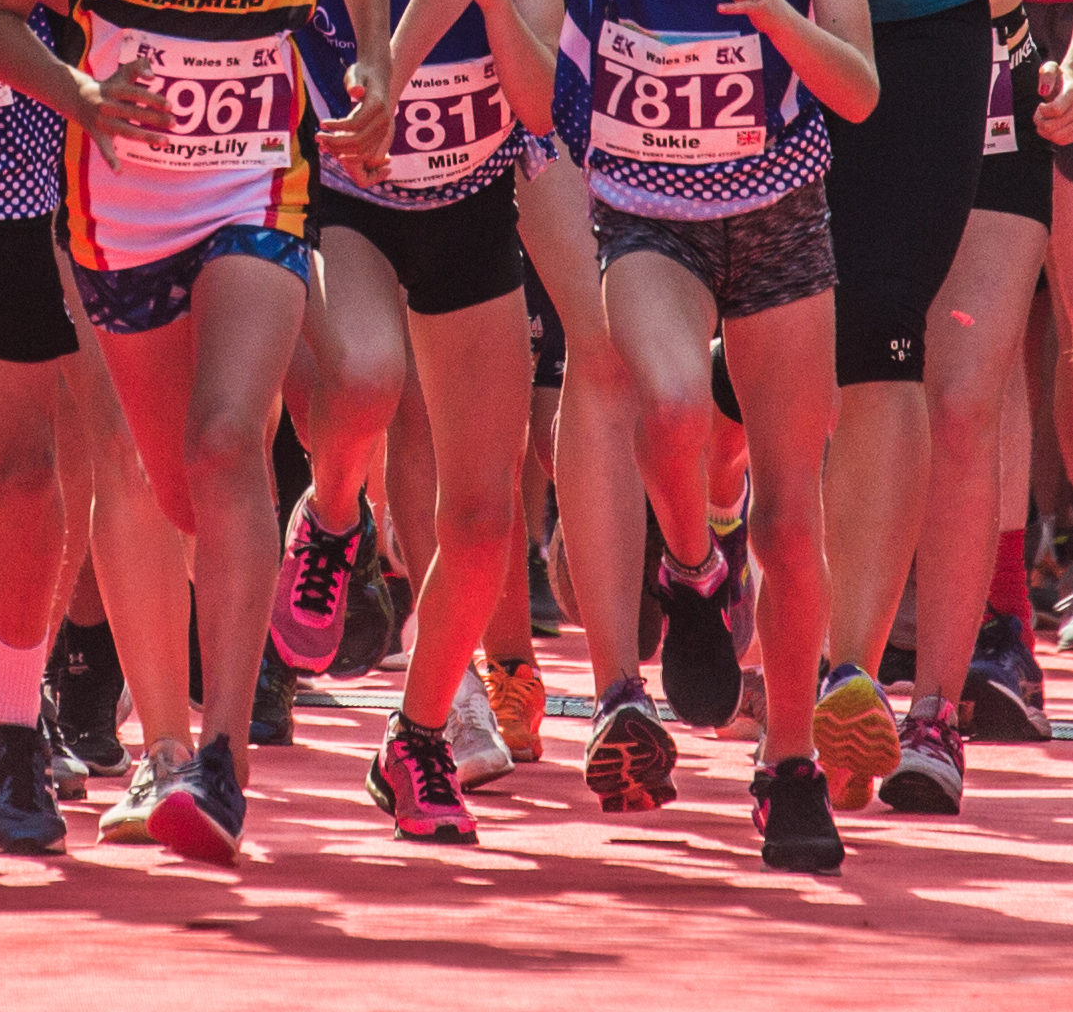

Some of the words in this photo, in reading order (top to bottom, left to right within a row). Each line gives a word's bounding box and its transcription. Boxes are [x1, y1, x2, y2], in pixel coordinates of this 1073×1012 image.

[183, 56, 221, 67] Wales
[226, 57, 241, 67] 5k
[252, 47, 278, 67] 5K
[612, 33, 635, 59] 5K
[646, 51, 680, 66] Wales
[684, 54, 700, 63] 5k
[716, 46, 745, 65] 5K
[411, 77, 450, 89] Wales
[454, 73, 470, 84] 5k
[605, 59, 756, 128] 7812
[395, 88, 512, 152] 811
[642, 133, 700, 149] Sukie
[428, 152, 469, 169] Mila
